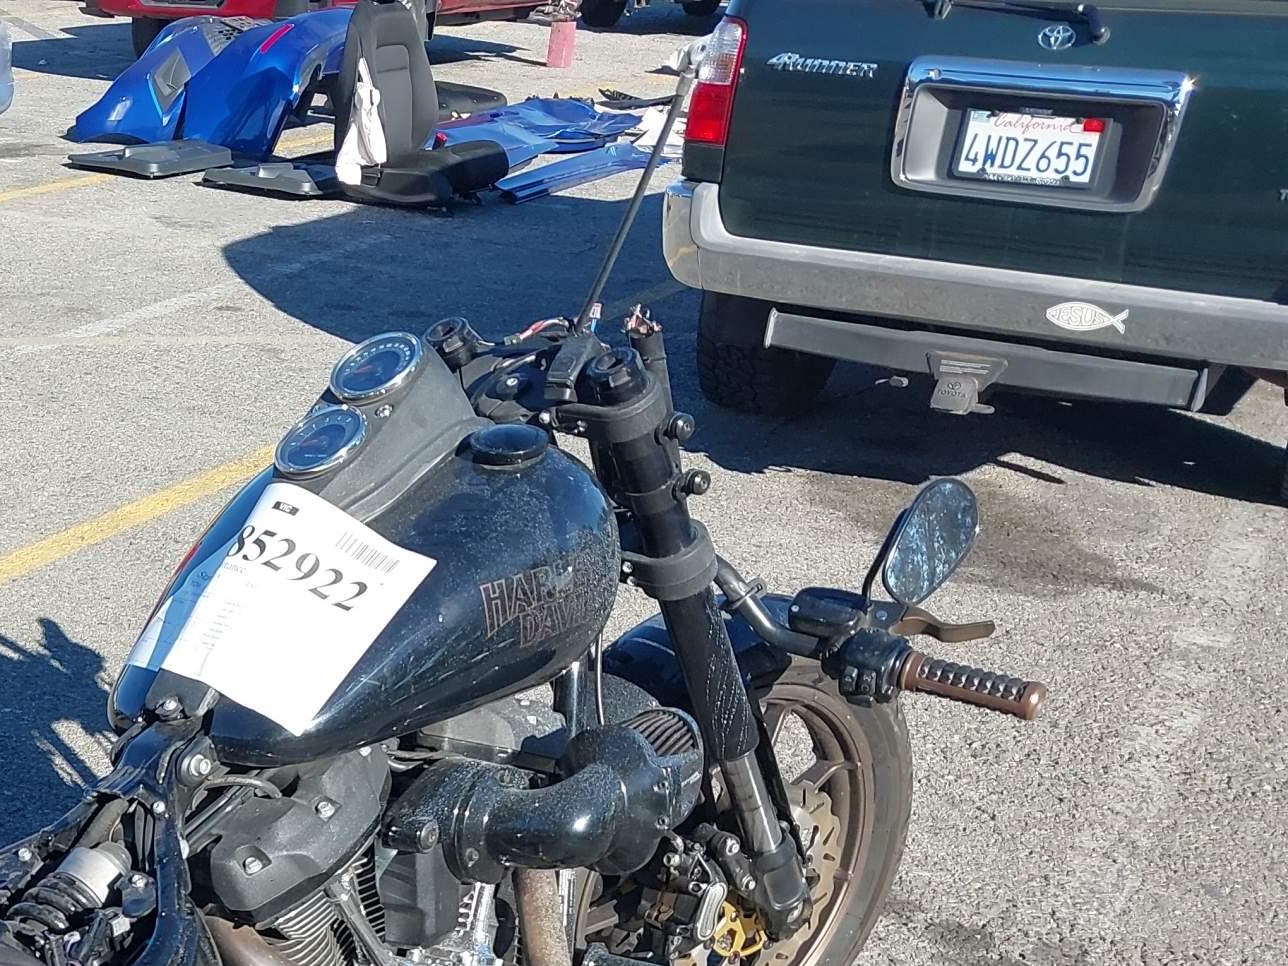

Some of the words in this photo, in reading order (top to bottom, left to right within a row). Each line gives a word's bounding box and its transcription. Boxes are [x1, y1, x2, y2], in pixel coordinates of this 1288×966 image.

[993, 111, 1073, 134] California
[964, 133, 1093, 177] 4WDZ655
[1050, 305, 1106, 327] JESUS
[936, 387, 969, 400] TOYOTA
[225, 525, 369, 612] 852922
[478, 557, 596, 639] HARL
[519, 592, 590, 649] DAVI
